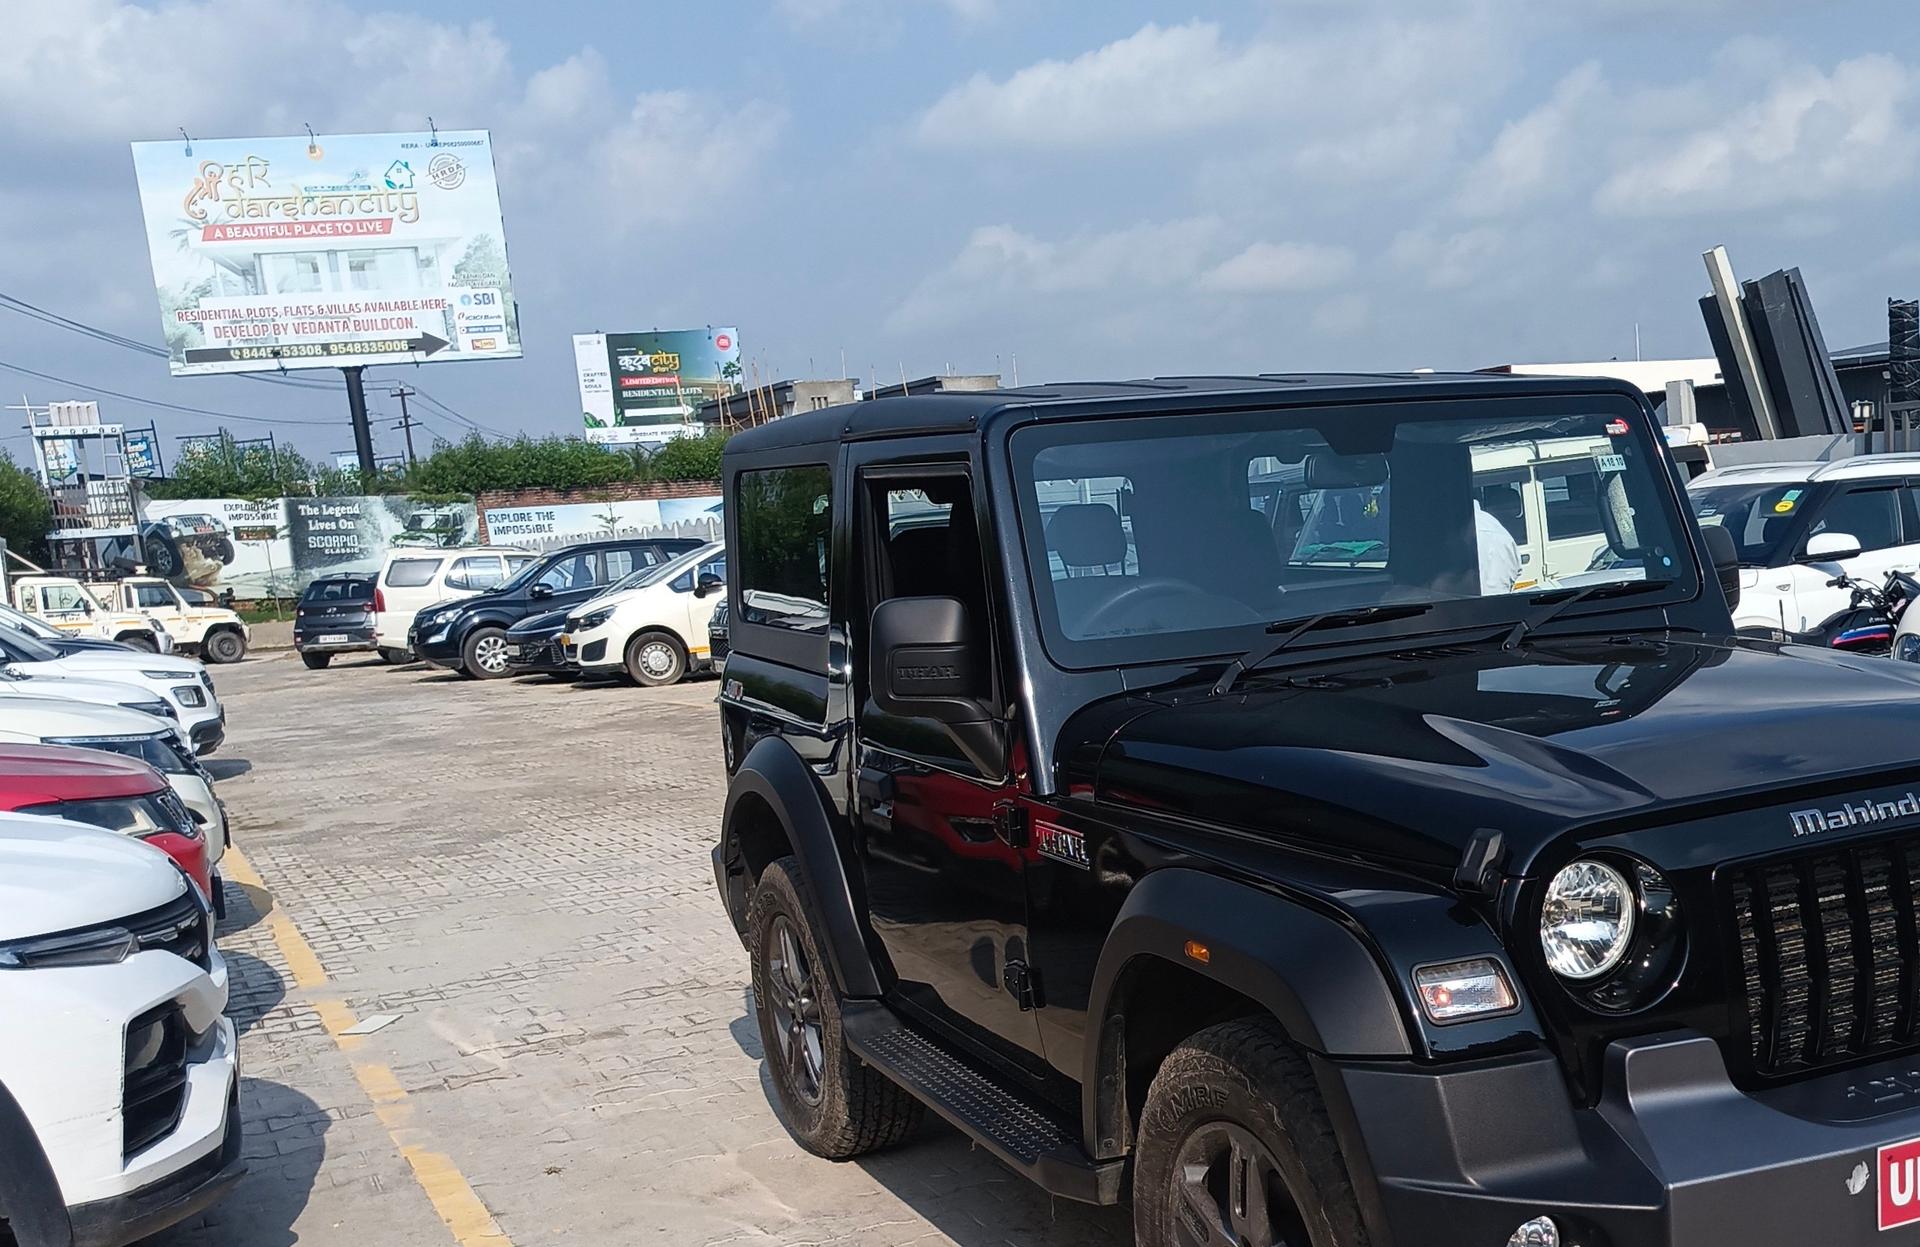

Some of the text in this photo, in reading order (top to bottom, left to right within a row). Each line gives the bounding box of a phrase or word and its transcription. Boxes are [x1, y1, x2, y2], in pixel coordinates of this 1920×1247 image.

[432, 163, 462, 181] HRDA
[213, 221, 384, 240] A BEAUTIFUL PLACE TO LIVE
[473, 292, 496, 306] SBI
[177, 308, 244, 322] RESIDENTIAL
[246, 306, 282, 319] PLOTS,
[283, 305, 315, 317] FLATS
[327, 302, 362, 314] VILLAS
[364, 300, 419, 313] AVAILABLE
[420, 298, 448, 310] HERE
[213, 317, 418, 339] DEVELOP BY VEDANTA BUILDCON.
[330, 340, 409, 355] 9548335006
[622, 388, 676, 398] RESIDENTIAL
[298, 503, 360, 517] The Legend
[487, 511, 555, 524] EXPLORE THE
[308, 519, 355, 531] Lives On
[494, 523, 554, 536] IMPOSSIBLE
[308, 534, 359, 549] SCORPIO
[896, 664, 960, 679] THAR
[1790, 792, 1920, 837] Mahind
[1890, 1156, 1920, 1207] U
